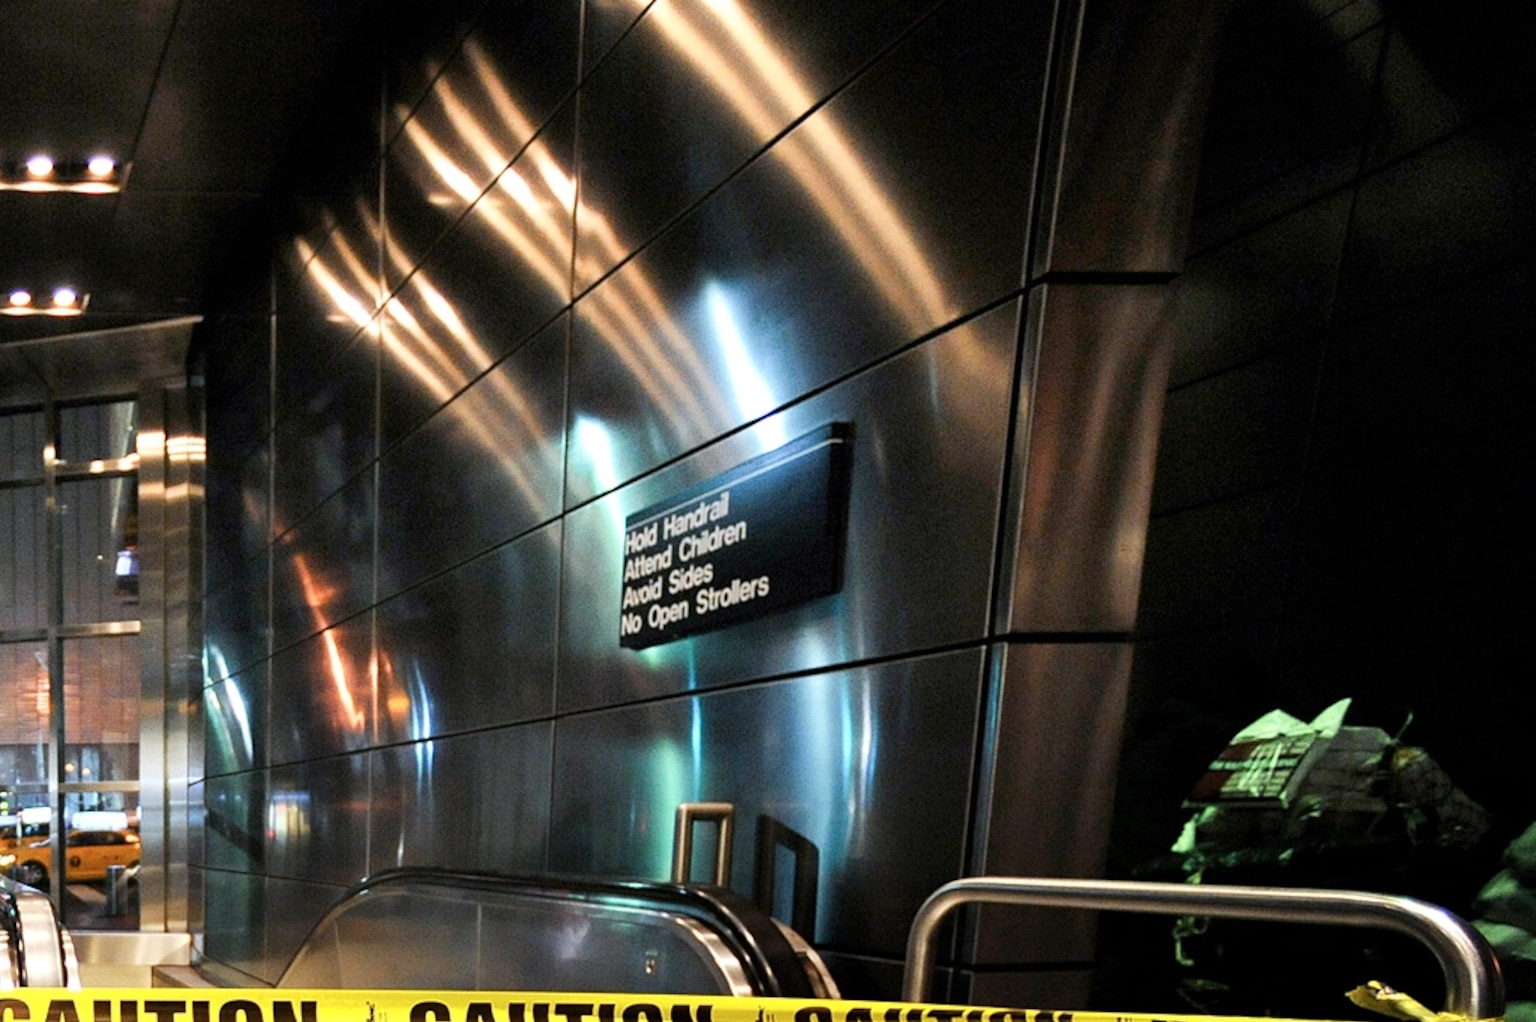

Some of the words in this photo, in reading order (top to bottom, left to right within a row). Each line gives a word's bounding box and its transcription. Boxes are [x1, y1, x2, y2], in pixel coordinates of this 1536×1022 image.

[625, 522, 658, 555] Hold
[664, 491, 730, 540] Handrail
[625, 544, 673, 581] Attend
[679, 521, 747, 562] Children
[621, 614, 642, 637] No
[648, 600, 689, 631] Open
[695, 575, 770, 615] Strollers
[623, 580, 662, 610] Avoid
[669, 563, 714, 595] Sides
